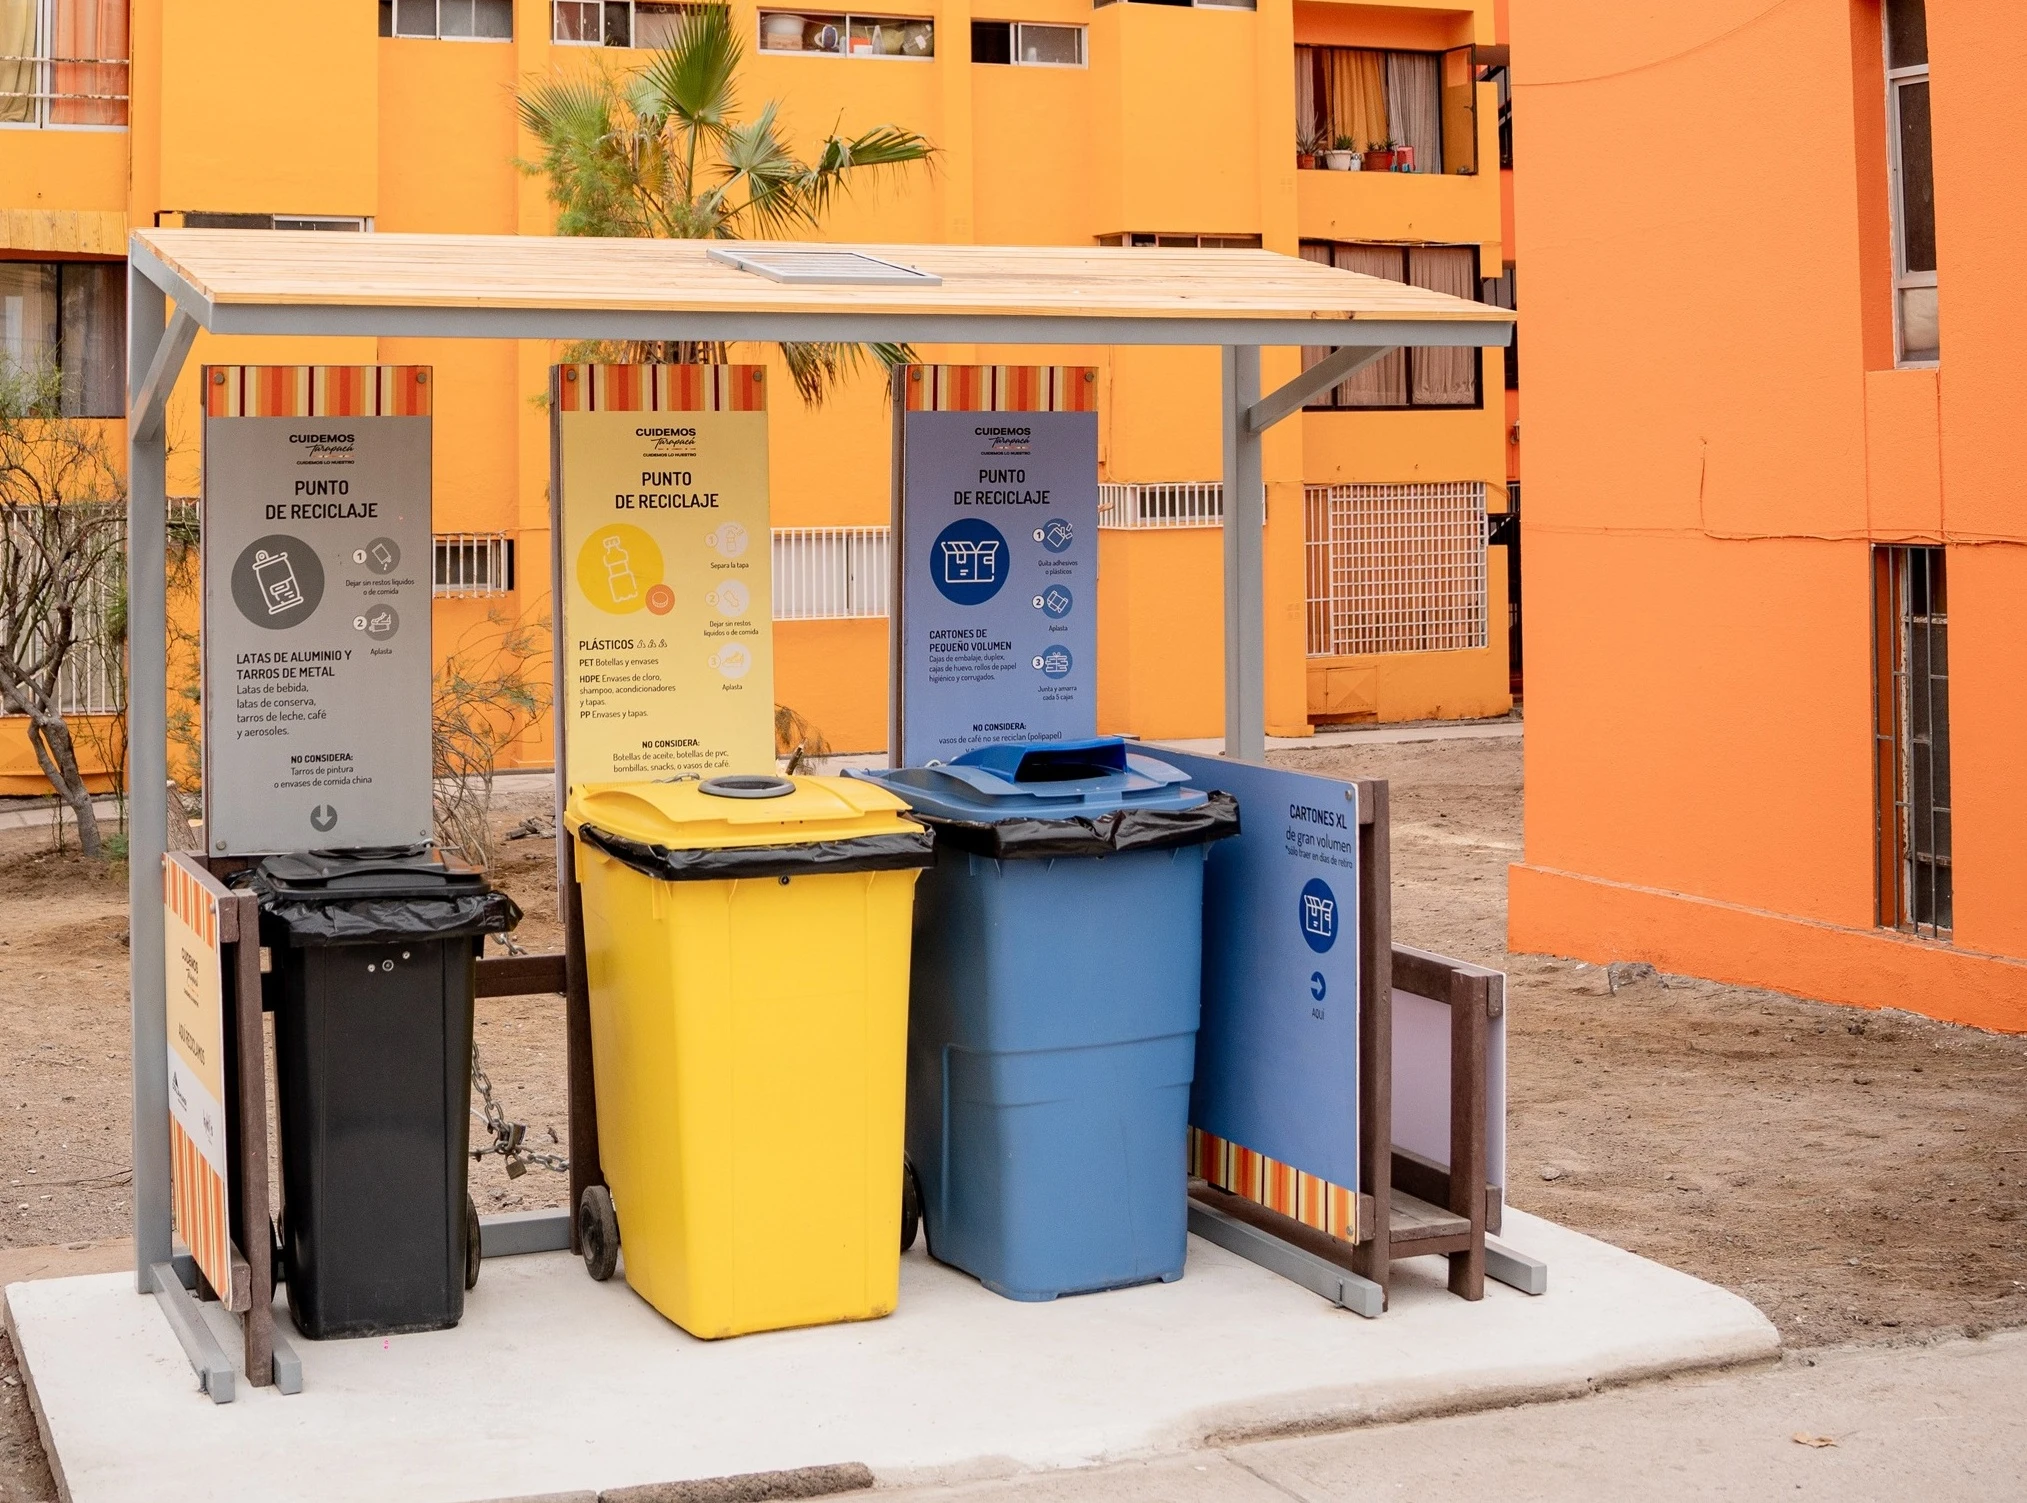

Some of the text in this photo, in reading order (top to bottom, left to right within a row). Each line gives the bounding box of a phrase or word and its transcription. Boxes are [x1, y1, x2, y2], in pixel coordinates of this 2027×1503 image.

[636, 428, 696, 437] CUIDEMOS
[975, 427, 1031, 436] CUIDEMOS
[289, 434, 355, 443] CUIDEMOS
[642, 472, 692, 486] PUNTO
[979, 469, 1025, 483] PUNTO
[295, 480, 349, 496] PUNTO
[615, 494, 719, 509] DE RECICLAJE
[954, 490, 1050, 505] DE RECICLAJE
[265, 503, 378, 520] DE RECICLAJE
[929, 629, 987, 639] CARTONES DE
[579, 638, 634, 650] PLÁSTICOS
[929, 641, 1012, 652] PEQUEÑO VOLUMEN
[236, 650, 352, 664] LATAS DE ALUMINIO Y
[596, 658, 623, 666] Botellas
[929, 655, 944, 663] Cajas
[1000, 663, 1016, 671] papel
[237, 667, 335, 680] TARROS DE METAL
[602, 674, 630, 682] Envases
[929, 674, 955, 683] higiénico
[961, 674, 995, 682] corrugados.
[237, 683, 309, 694] Latas de bebida,
[580, 684, 676, 695] shampoo, acondicionadores
[236, 698, 316, 709] latas de conserva,
[585, 698, 606, 707] tapas.
[237, 714, 264, 723] tarros
[266, 712, 277, 721] de
[307, 711, 327, 719] café
[592, 710, 621, 718] Envases
[628, 709, 648, 718] tapas.
[237, 726, 289, 739] y aerosoles.
[985, 723, 1026, 731] CONSIDERA:
[1001, 732, 1026, 741] reciclan
[1028, 731, 1062, 741] (polipapel)
[655, 738, 700, 748] CONSIDERA:
[291, 753, 353, 764] NO CONSIDERA:
[613, 753, 640, 761] Botellas
[291, 765, 354, 776] Tarros de pintura
[614, 763, 649, 772] bombillas,
[650, 762, 675, 771] snacks,
[713, 760, 730, 768] café.
[280, 779, 311, 788] envases
[324, 778, 351, 786] comida
[352, 776, 372, 784] china
[1290, 804, 1347, 830] CARTONES XL
[1286, 826, 1351, 853] de gran volumen
[1299, 850, 1310, 859] traer
[1331, 856, 1337, 865] de
[1338, 857, 1353, 869] retiro
